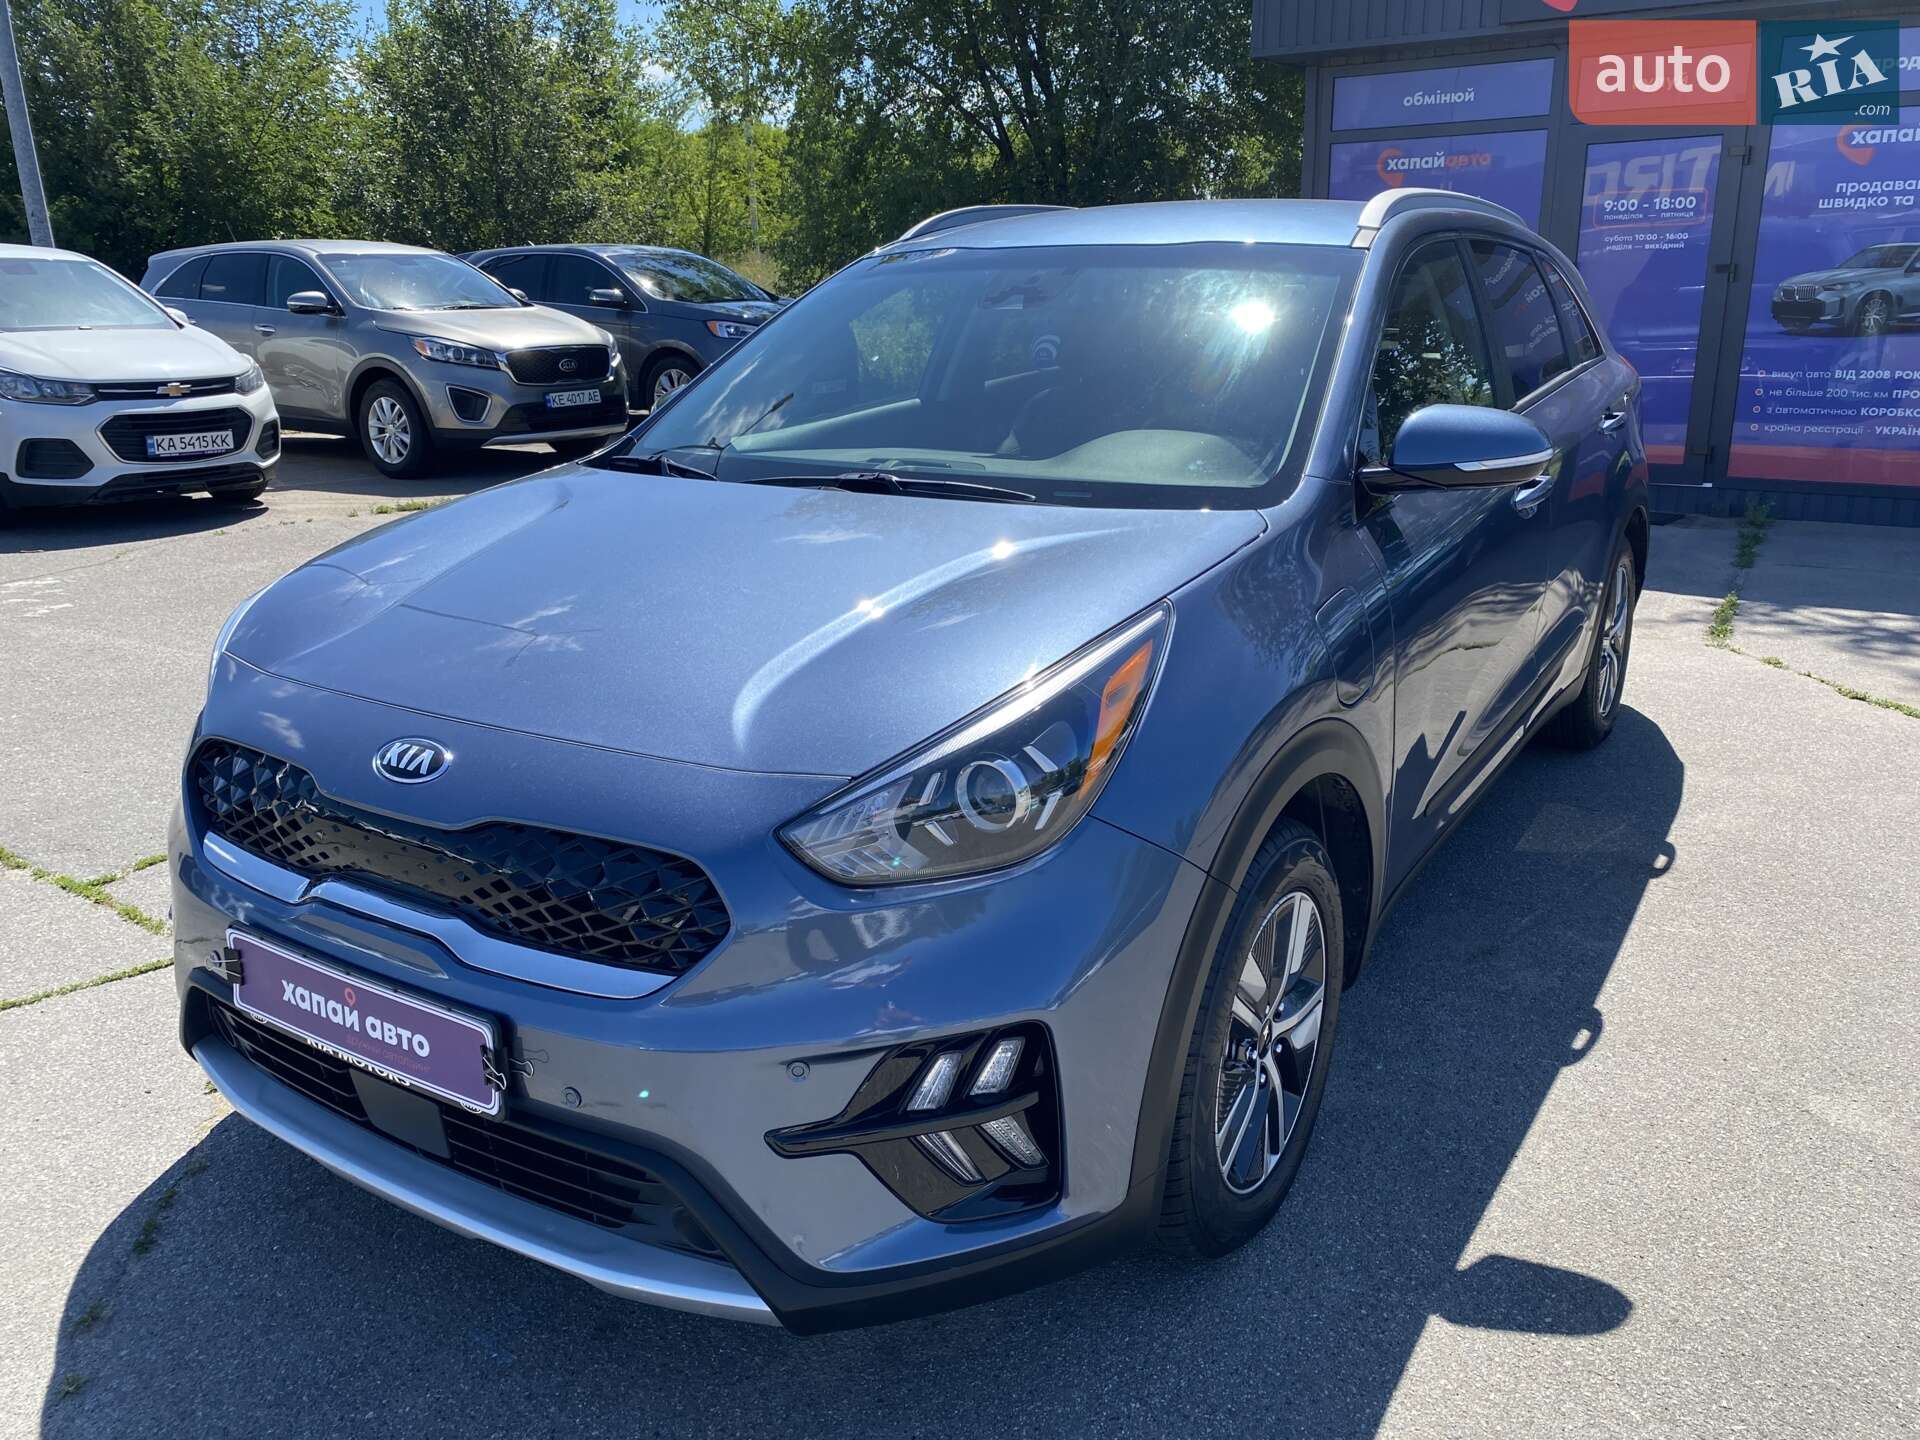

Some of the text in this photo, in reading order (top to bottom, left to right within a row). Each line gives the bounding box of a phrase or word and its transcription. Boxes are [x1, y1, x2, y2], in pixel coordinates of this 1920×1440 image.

[1403, 87, 1474, 107] обмінюй
[1603, 199, 1638, 212] 9:00
[1653, 196, 1697, 210] 18:00
[1818, 195, 1914, 210] швидко та
[1605, 234, 1633, 243] субота
[1806, 371, 1831, 379] авто
[1834, 369, 1857, 380] ВІД
[1859, 370, 1891, 379] 2008
[567, 392, 585, 405] 4017
[1769, 389, 1783, 397] не
[1785, 387, 1823, 397] більше
[1826, 388, 1848, 398] 200
[1873, 391, 1889, 399] км
[1775, 406, 1857, 416] автоматичною
[1764, 423, 1801, 433] країна
[155, 433, 231, 452] KA 5415 KK
[382, 742, 435, 775] KIA
[365, 1015, 430, 1058] авто
